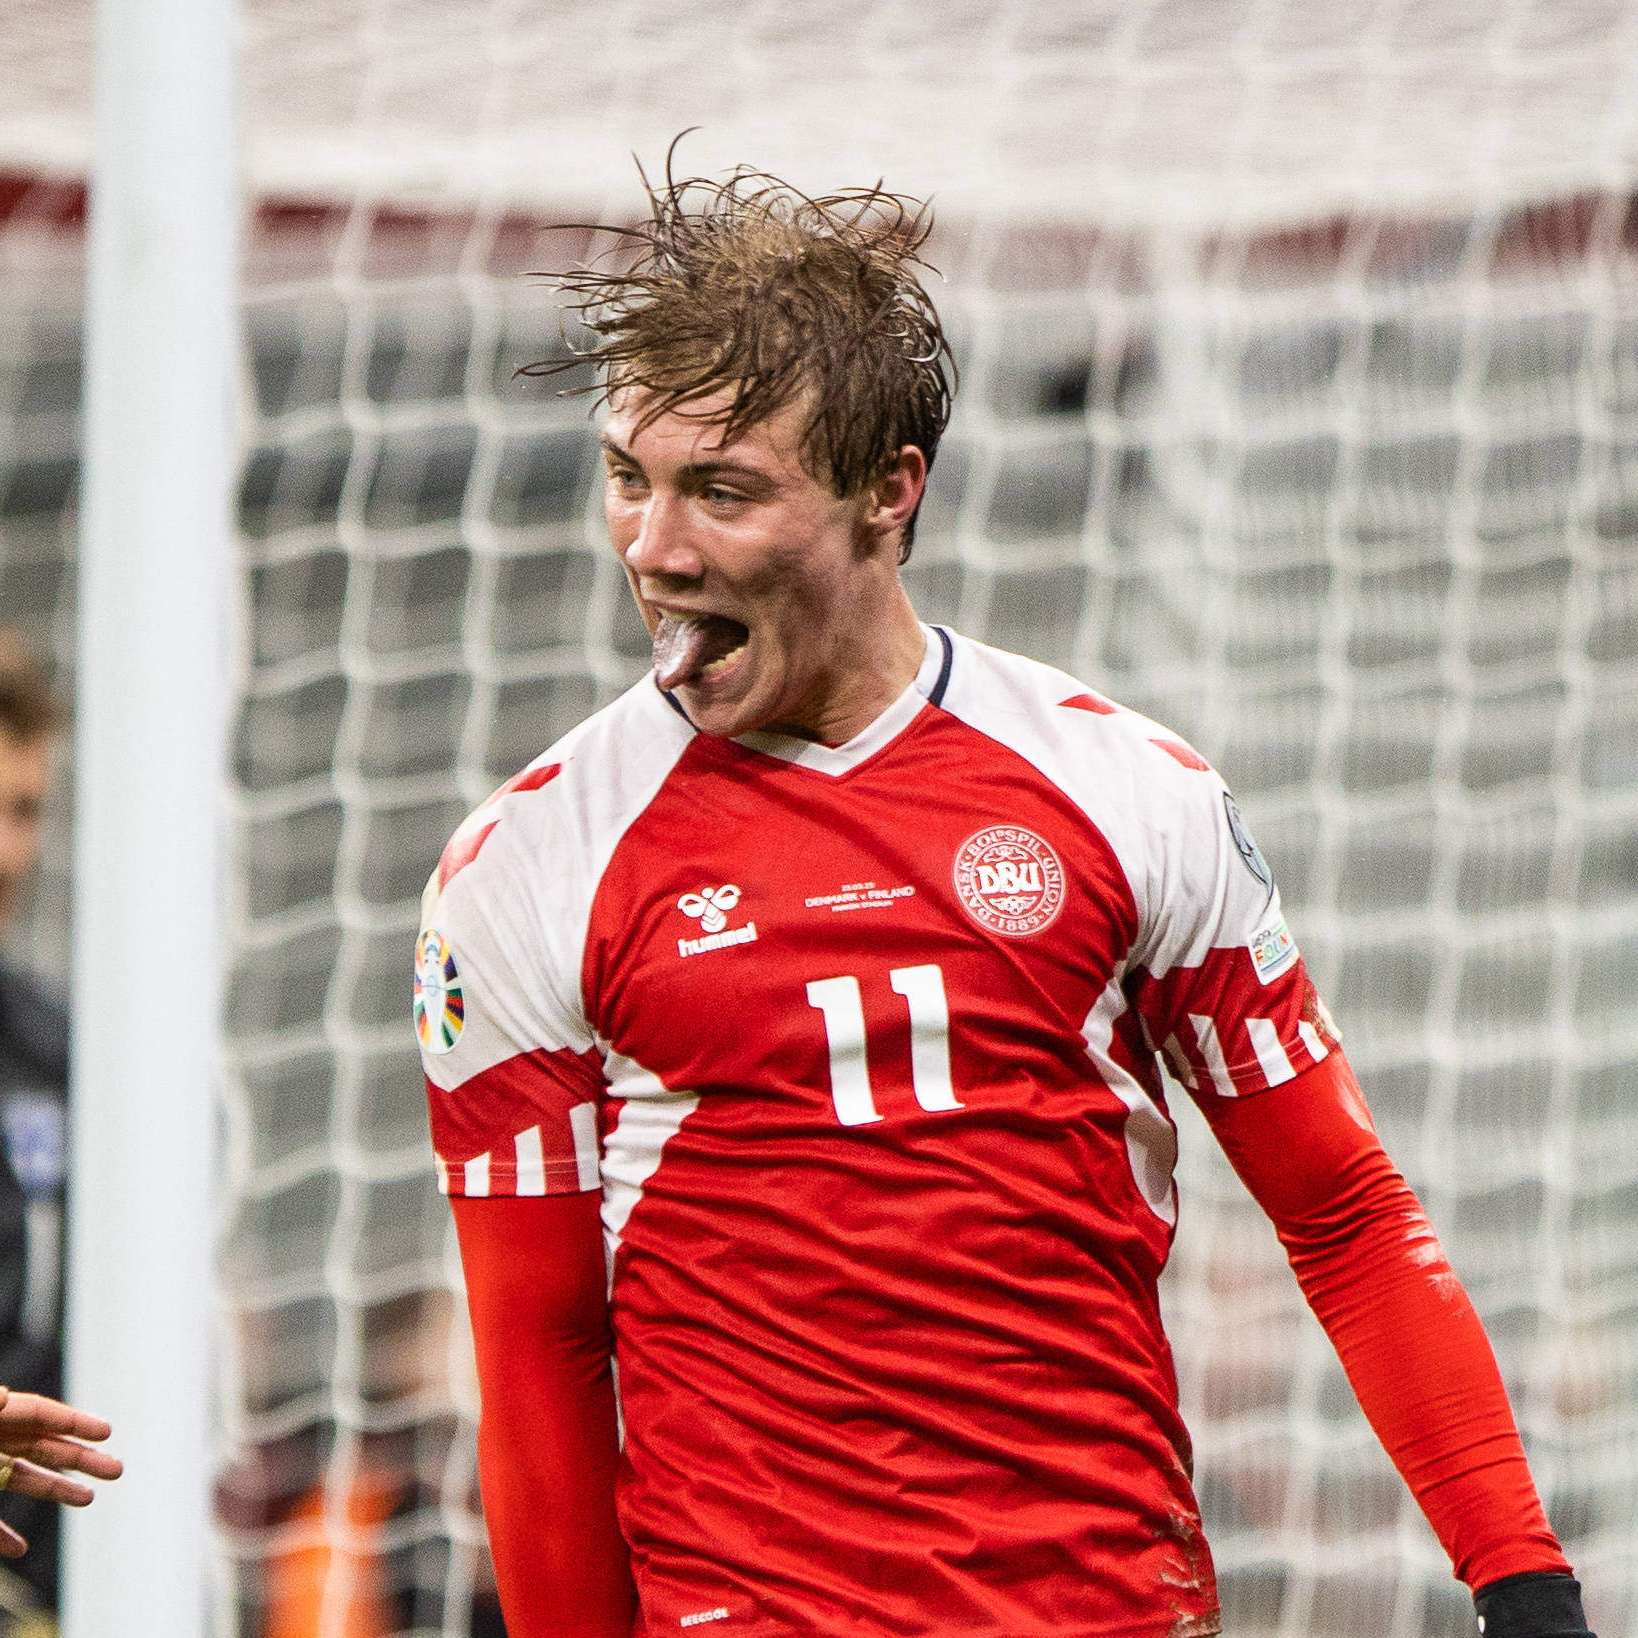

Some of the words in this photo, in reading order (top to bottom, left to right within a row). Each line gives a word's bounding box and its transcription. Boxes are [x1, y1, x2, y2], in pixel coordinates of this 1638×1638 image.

[976, 861, 1044, 895] DBU
[1042, 857, 1061, 916] UNION
[804, 892, 859, 908] DENMARK
[867, 885, 916, 900] FINLAND
[677, 920, 758, 958] hummel
[998, 915, 1040, 932] 1889
[806, 963, 965, 1127] 11
[680, 1606, 730, 1628] BEECOOL
